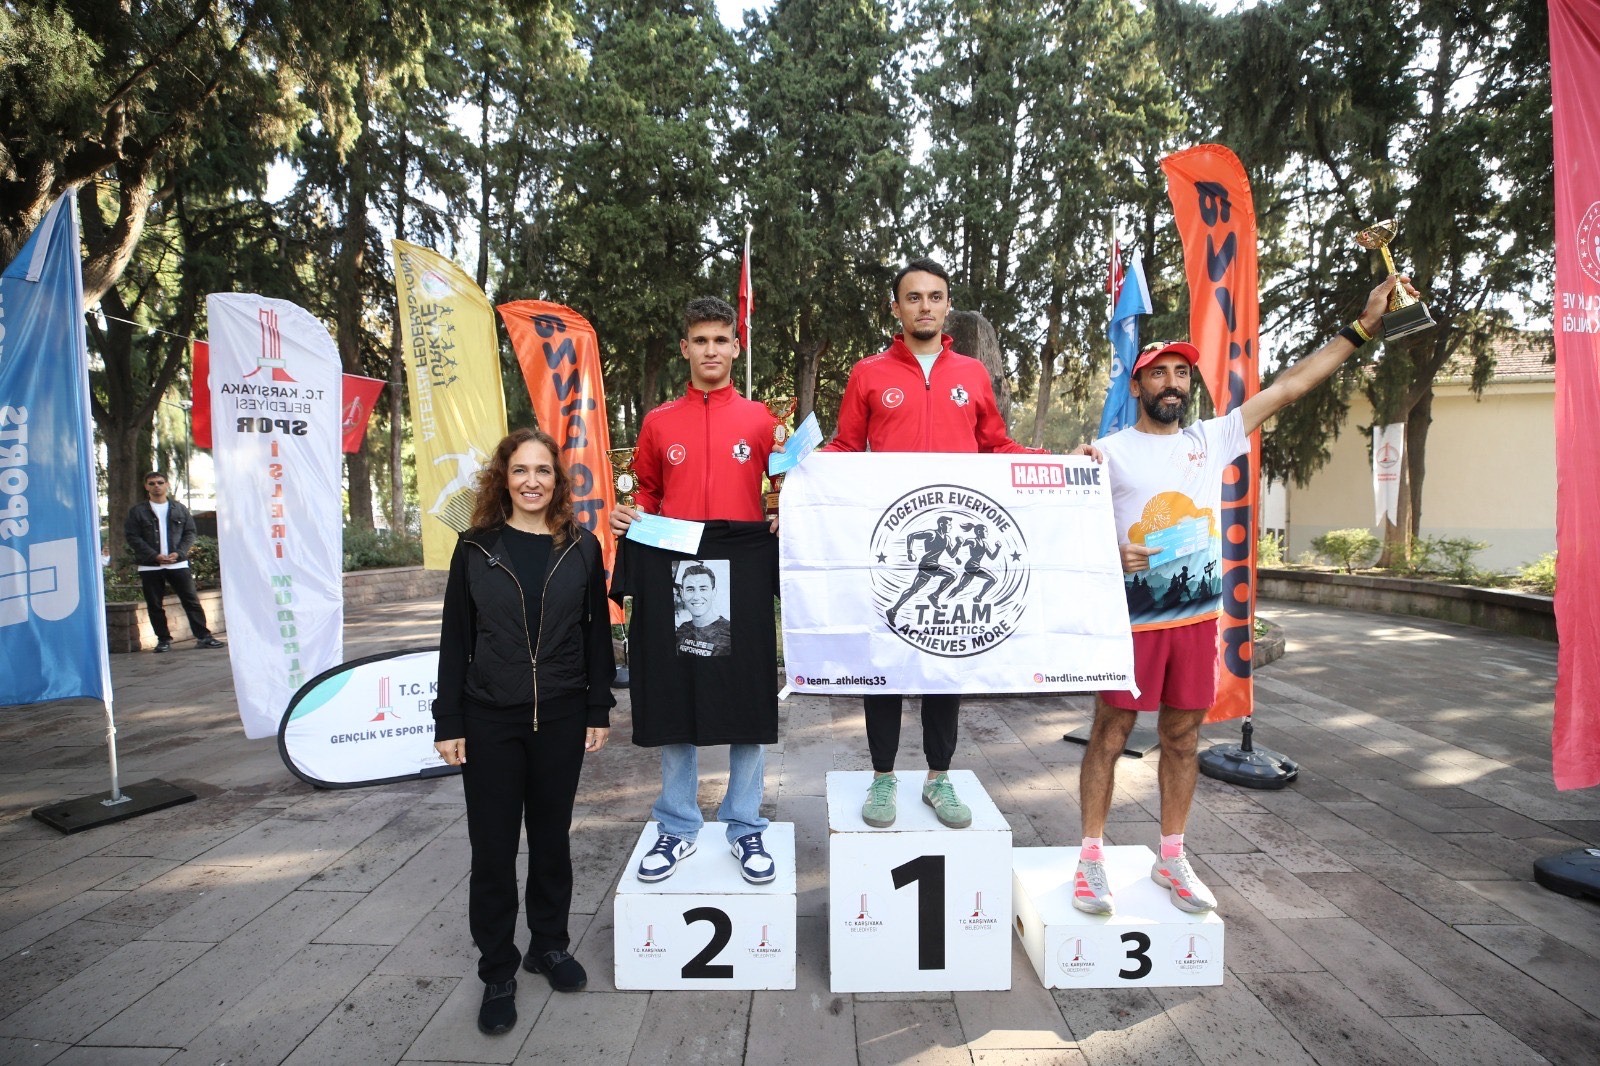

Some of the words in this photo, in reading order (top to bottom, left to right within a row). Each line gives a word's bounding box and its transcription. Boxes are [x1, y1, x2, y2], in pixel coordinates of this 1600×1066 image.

[883, 492, 944, 532] TOGETHER
[948, 492, 1012, 533] EVERYONE
[915, 603, 992, 625] T.E.A.M
[898, 623, 967, 652] ACHIEVES
[971, 620, 1011, 648] MORE
[923, 625, 985, 636] ATHLETICS
[399, 684, 425, 696] T.C.
[1045, 673, 1126, 683] hardline.nutrition
[330, 730, 377, 745] GENÇLİK
[380, 729, 393, 738] VE
[396, 725, 424, 737] SPOR
[891, 855, 945, 970] 1
[681, 906, 734, 979] 2
[1118, 931, 1153, 980] 3
